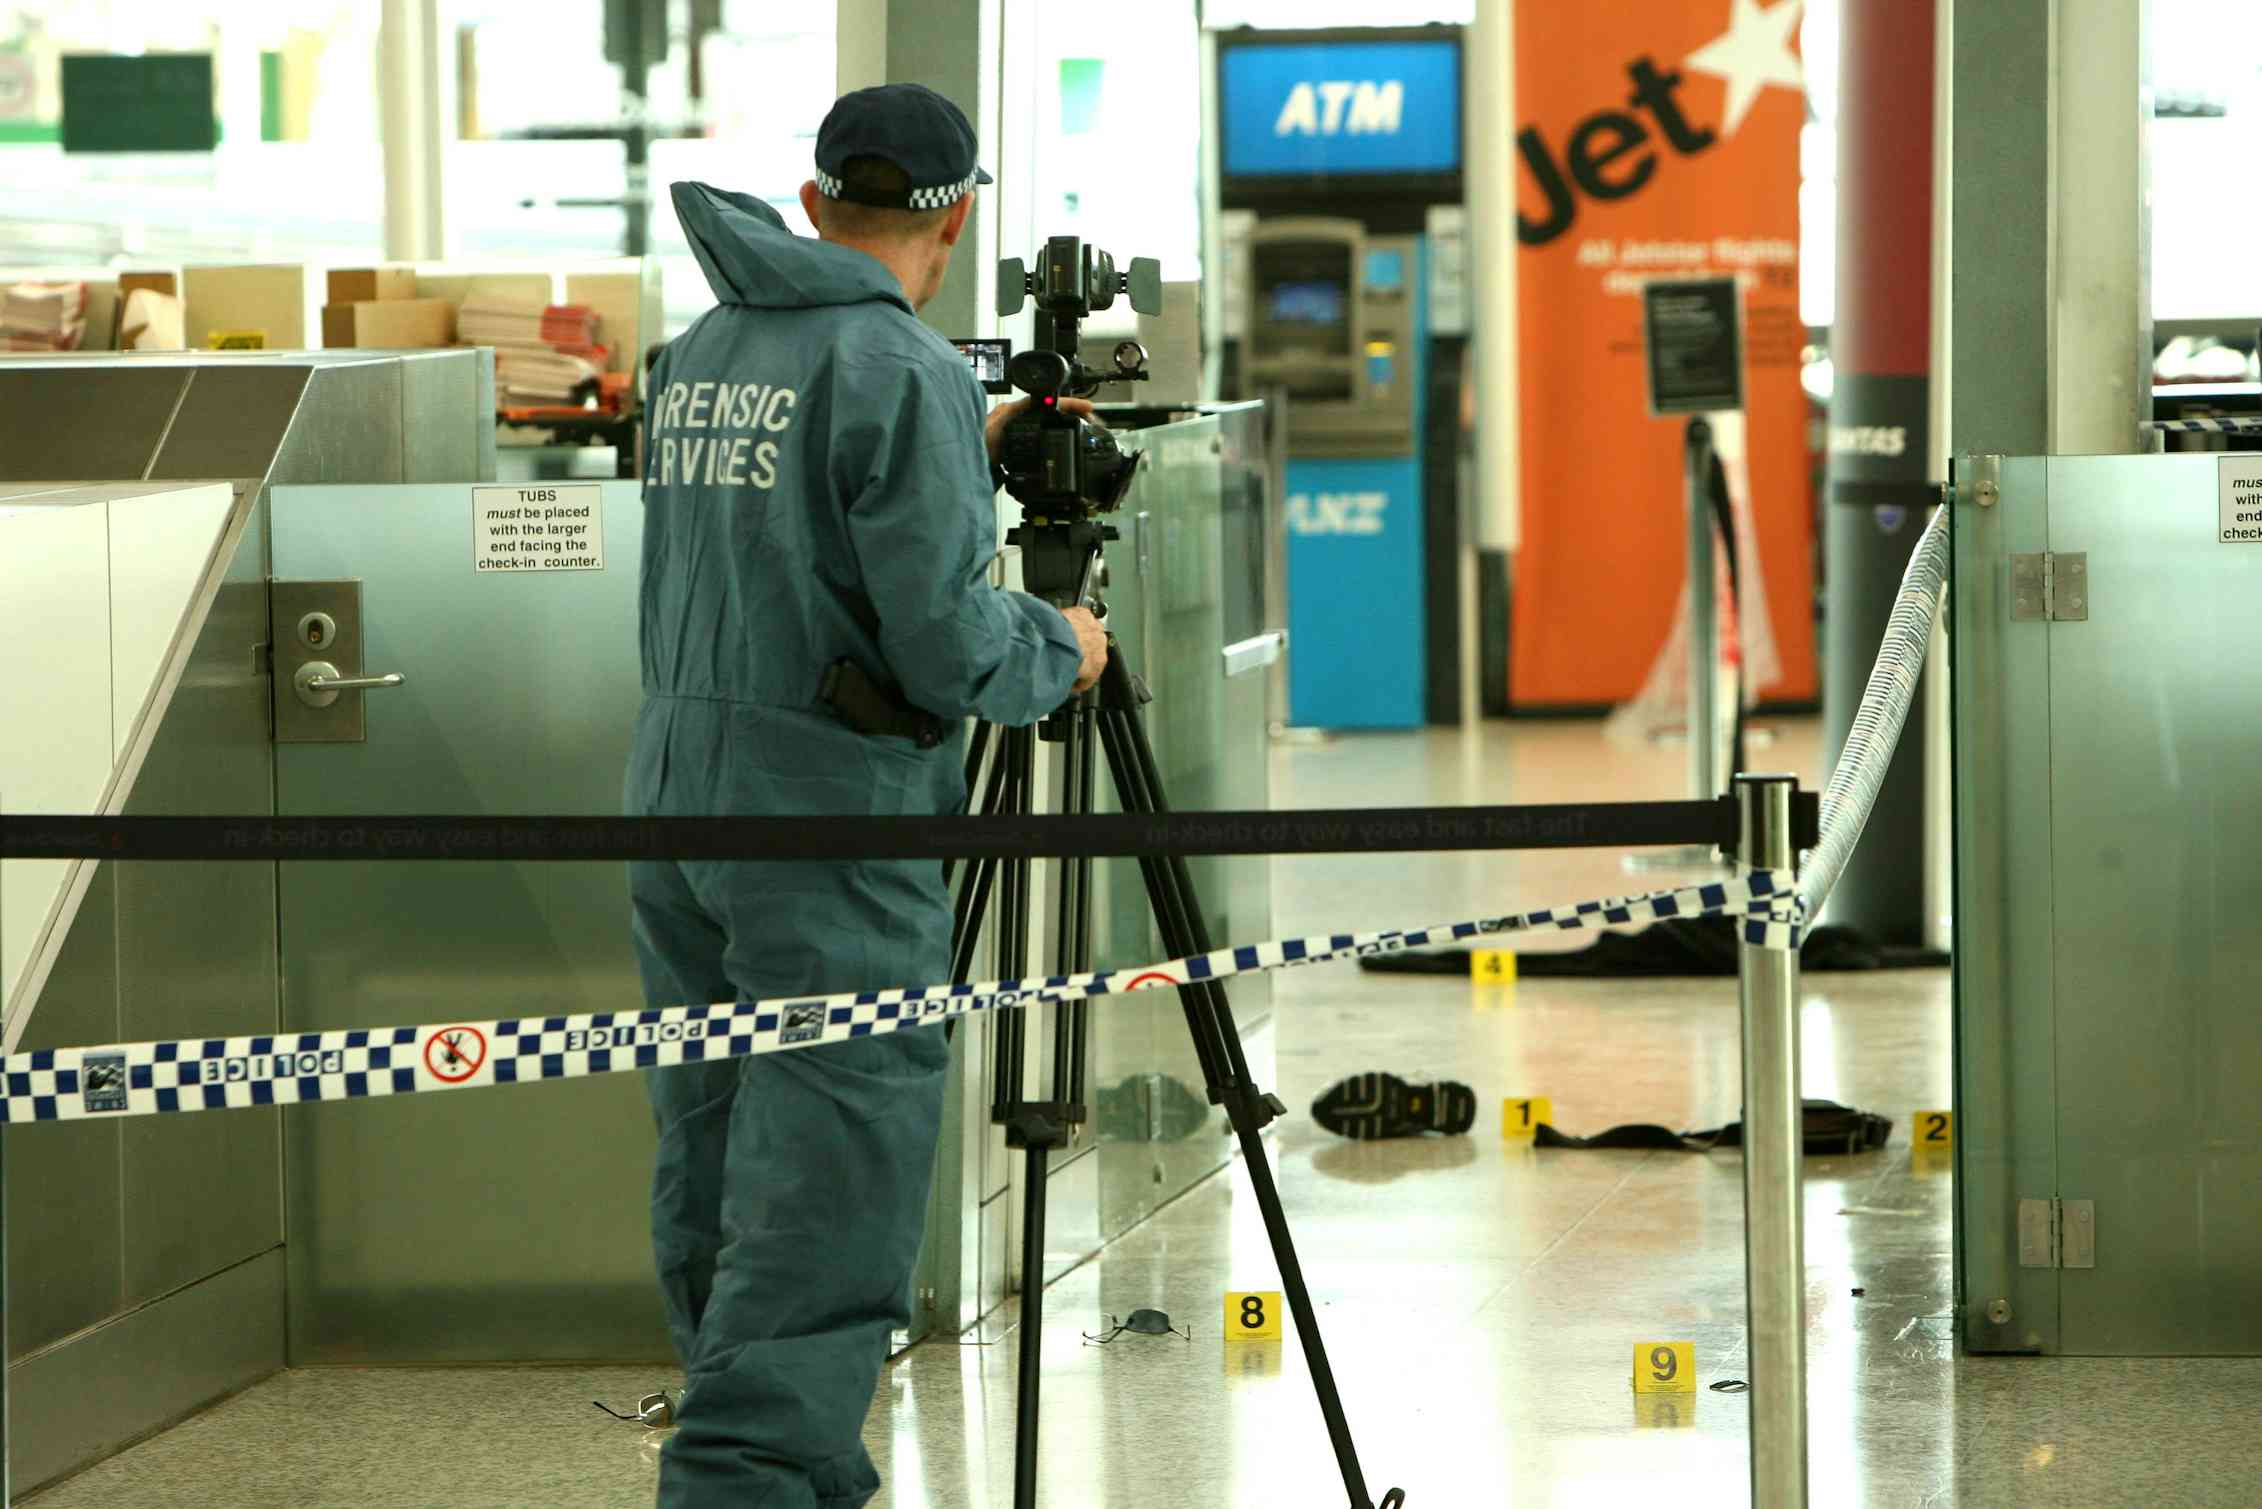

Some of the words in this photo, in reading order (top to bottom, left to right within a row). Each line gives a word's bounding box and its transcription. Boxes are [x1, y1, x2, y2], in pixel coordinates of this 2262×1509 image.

[1274, 80, 1404, 136] ATM
[1516, 54, 1716, 246] Jet
[518, 489, 557, 503] TUBS
[2232, 478, 2262, 490] mus
[487, 508, 520, 519] must
[524, 507, 540, 518] be
[545, 506, 589, 520] placed
[490, 524, 518, 536] with
[522, 523, 543, 535] the
[547, 523, 587, 537] larger
[490, 541, 516, 553] end
[520, 541, 561, 553] facing
[565, 539, 587, 551] the
[478, 556, 536, 569] check-in
[544, 556, 600, 568] counter.
[1485, 954, 1501, 974] 4
[570, 1021, 705, 1051] POLICE
[206, 1050, 343, 1083] POLICE
[1516, 1100, 1531, 1126] 1
[1926, 1114, 1947, 1140] 2
[1240, 1295, 1265, 1328] 8
[1650, 1346, 1678, 1381] 9
